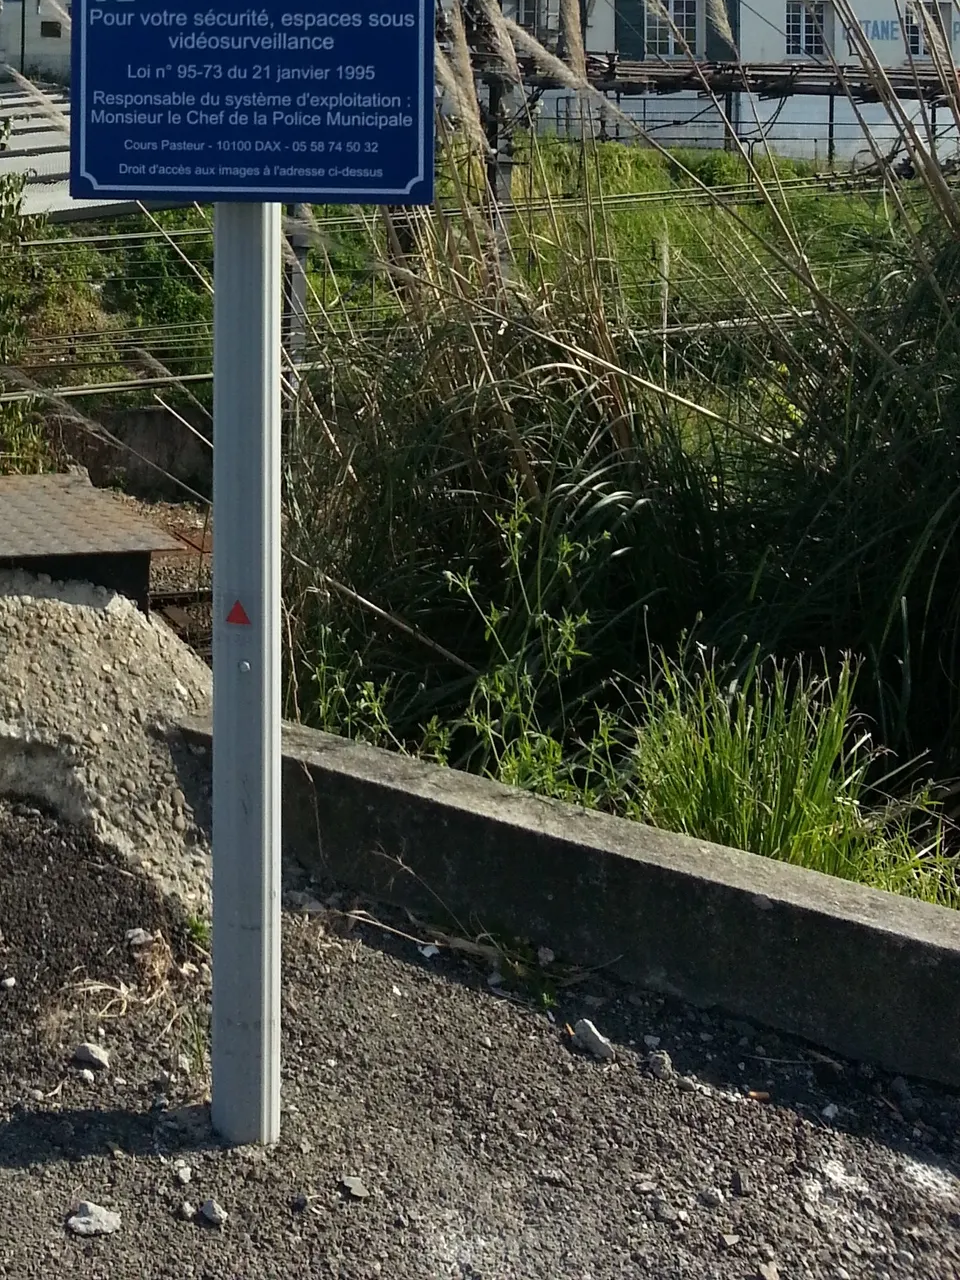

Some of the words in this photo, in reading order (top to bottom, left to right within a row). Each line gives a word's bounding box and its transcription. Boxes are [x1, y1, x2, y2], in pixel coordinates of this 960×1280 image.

[90, 8, 135, 27] Pour
[139, 9, 188, 27] votre
[193, 8, 275, 30] sécurité,
[281, 12, 363, 31] espaces
[368, 13, 415, 28] sous
[168, 31, 335, 50] vidéosurveillance
[127, 64, 151, 79] Loi
[155, 64, 172, 79] n°
[177, 64, 223, 80] 95-73
[227, 65, 247, 80] du
[252, 65, 271, 80] 21
[276, 65, 331, 84] janvier
[336, 65, 376, 81] 1995
[93, 90, 196, 109] Responsable
[200, 91, 220, 107] du
[224, 91, 291, 110] système
[296, 93, 401, 111] d'exploitation
[91, 109, 163, 125] Monsieur
[167, 110, 181, 125] le
[186, 110, 225, 126] Chef
[228, 111, 248, 126] de
[253, 111, 267, 126] la
[273, 112, 321, 127] Police
[326, 112, 413, 130] Municipale
[124, 139, 158, 151] Cours
[161, 139, 205, 151] Pasteur
[255, 140, 281, 152] DAX
[292, 141, 307, 153] 05
[310, 141, 325, 153] 58
[328, 141, 342, 153] 74
[346, 141, 361, 154] 50
[364, 142, 379, 154] 32
[119, 163, 146, 175] Droit
[148, 164, 191, 176] d'accès
[195, 166, 216, 177] aux
[218, 165, 260, 179] images
[263, 165, 271, 177] à
[274, 165, 325, 177] l'adresse
[328, 165, 384, 178] ci-dessus
